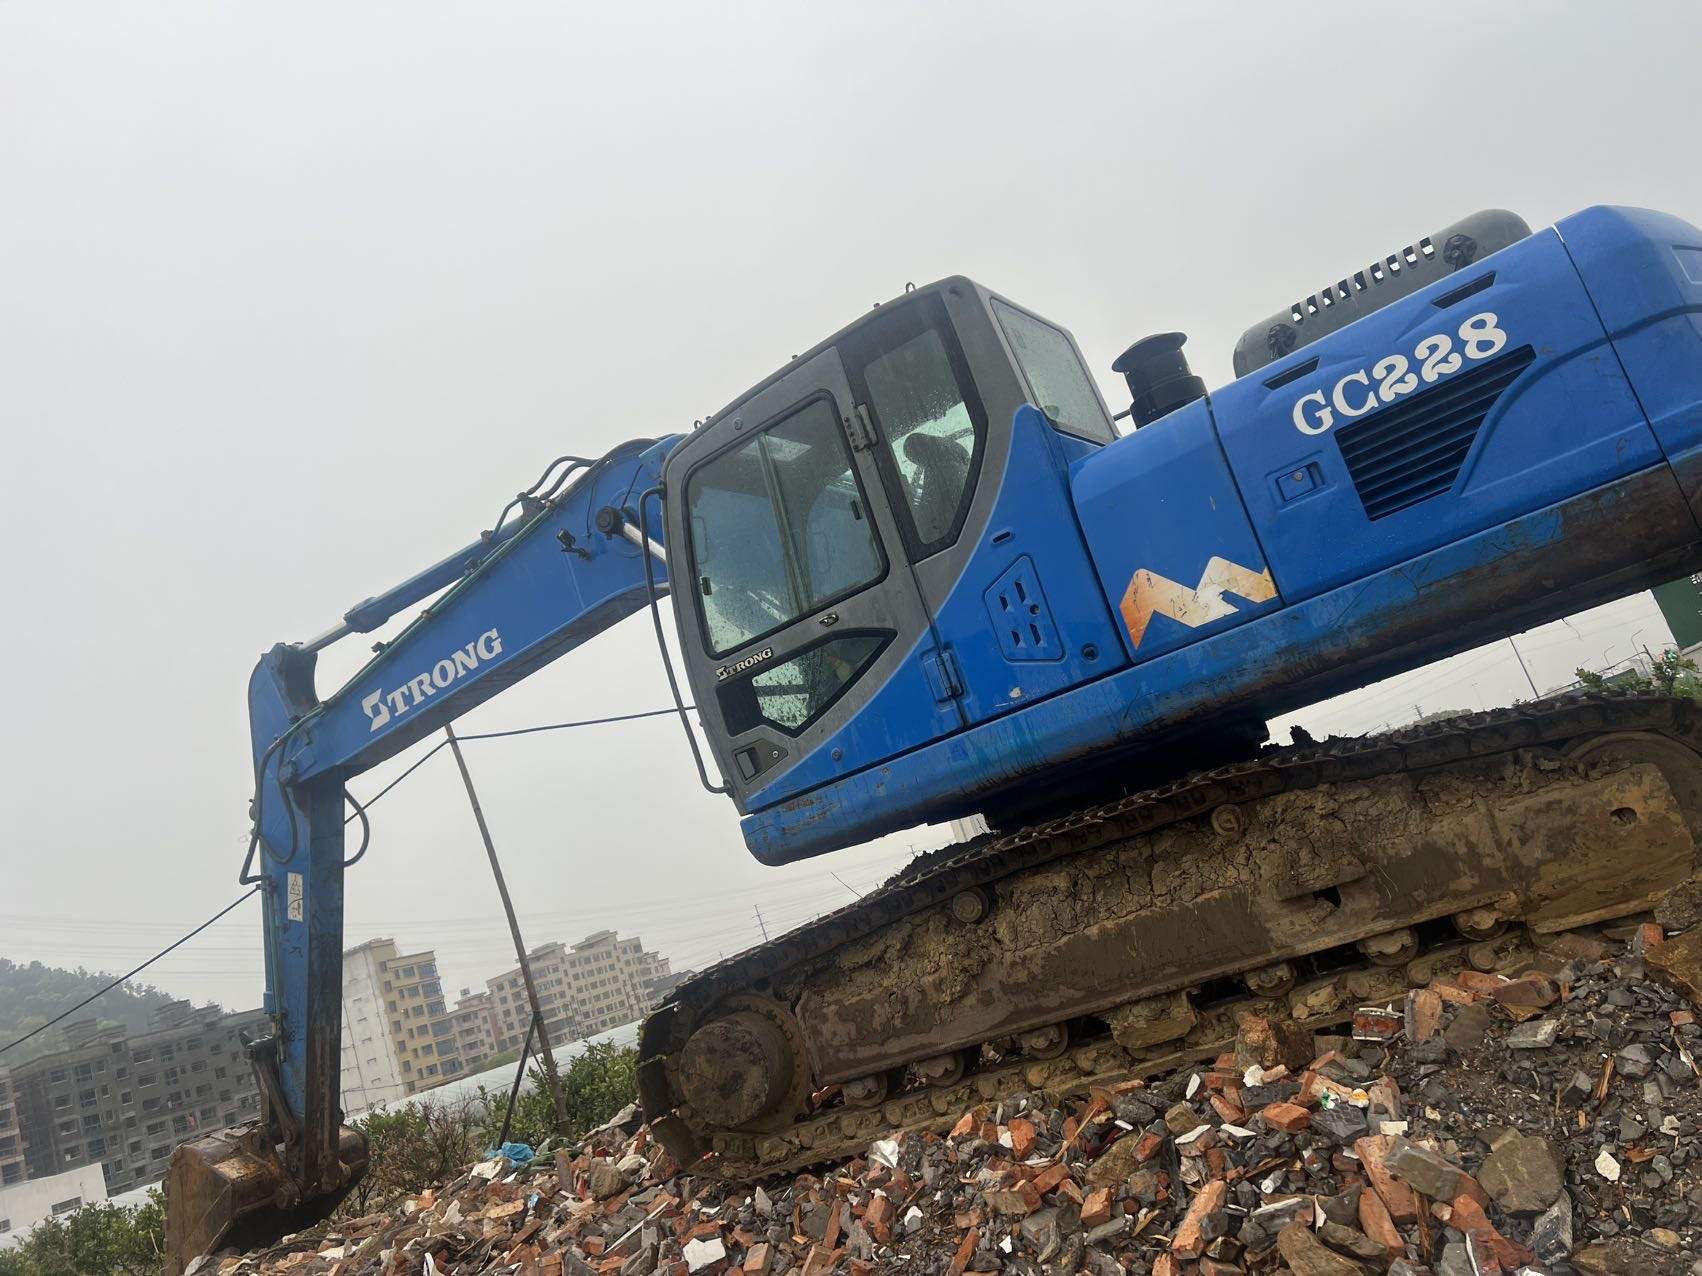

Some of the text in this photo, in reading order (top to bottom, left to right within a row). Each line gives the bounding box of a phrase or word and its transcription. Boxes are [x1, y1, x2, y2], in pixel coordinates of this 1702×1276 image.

[1292, 312, 1507, 436] GC228
[361, 628, 503, 733] STRONG
[715, 647, 773, 681] STRONG
